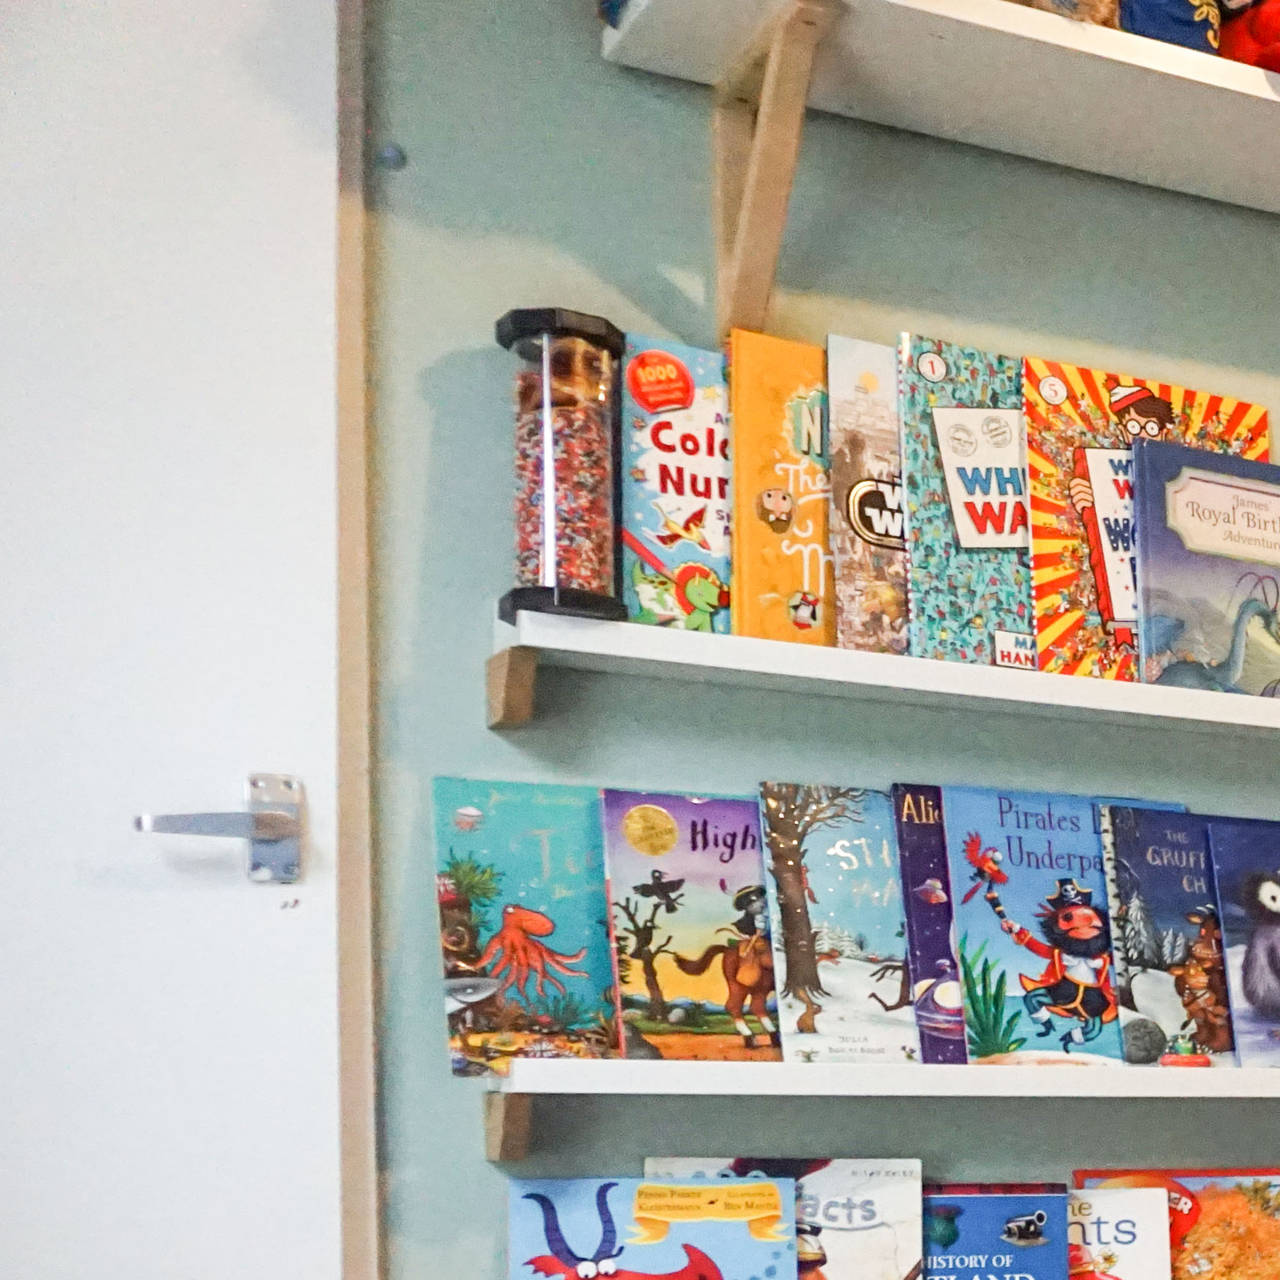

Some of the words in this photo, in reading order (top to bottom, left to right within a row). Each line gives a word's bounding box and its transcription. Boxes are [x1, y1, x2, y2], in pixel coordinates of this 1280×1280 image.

[637, 363, 678, 383] 1000
[956, 467, 1027, 496] WH
[1185, 500, 1237, 527] Royal
[998, 796, 1081, 832] Pirates
[690, 818, 757, 864] High
[1165, 829, 1190, 844] THE
[992, 1254, 1015, 1269] OF
